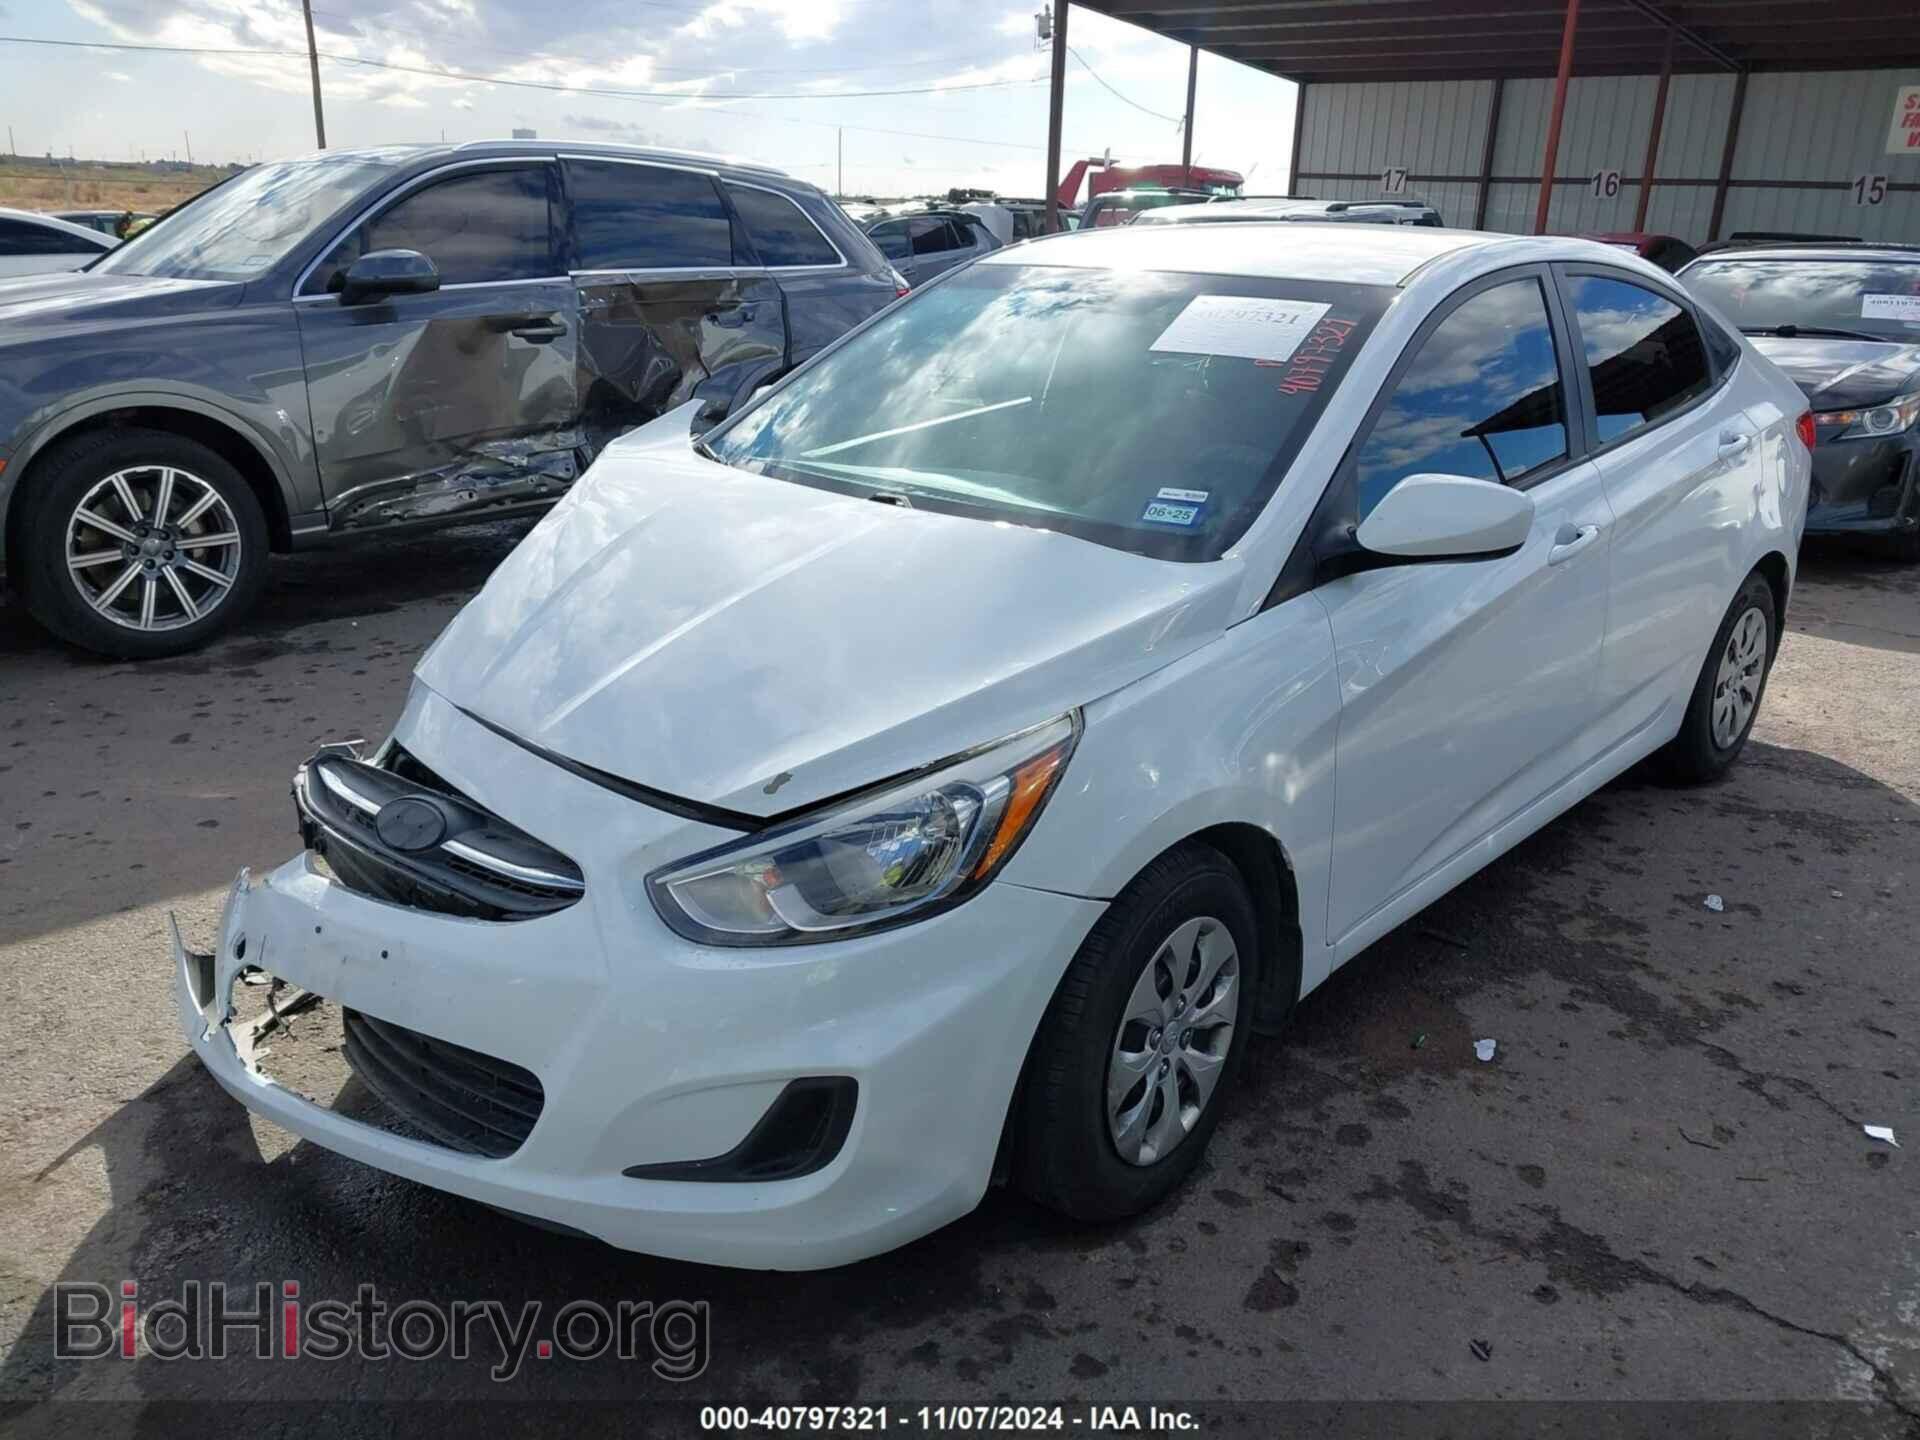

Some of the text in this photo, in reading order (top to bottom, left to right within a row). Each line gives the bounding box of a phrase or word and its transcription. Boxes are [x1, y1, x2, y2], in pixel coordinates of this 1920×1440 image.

[1383, 169, 1406, 192] 17
[1592, 172, 1618, 197] 16
[1855, 176, 1885, 204] 15
